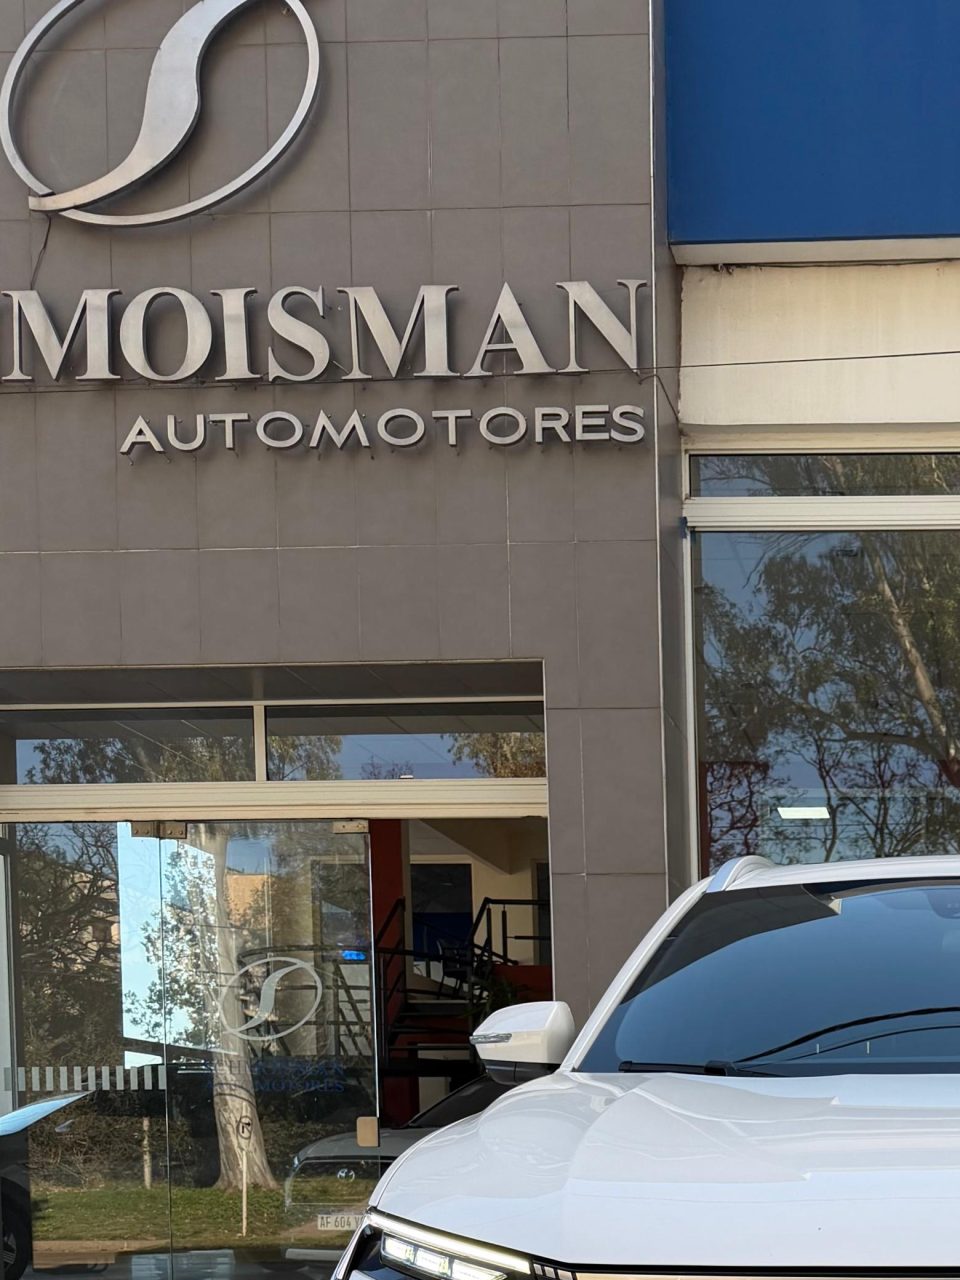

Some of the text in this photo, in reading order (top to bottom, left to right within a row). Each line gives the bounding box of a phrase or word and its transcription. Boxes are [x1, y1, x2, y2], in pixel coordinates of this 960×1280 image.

[2, 279, 648, 382] MOISMAN
[119, 404, 644, 455] AUTOMOTORES
[320, 1216, 331, 1228] AF
